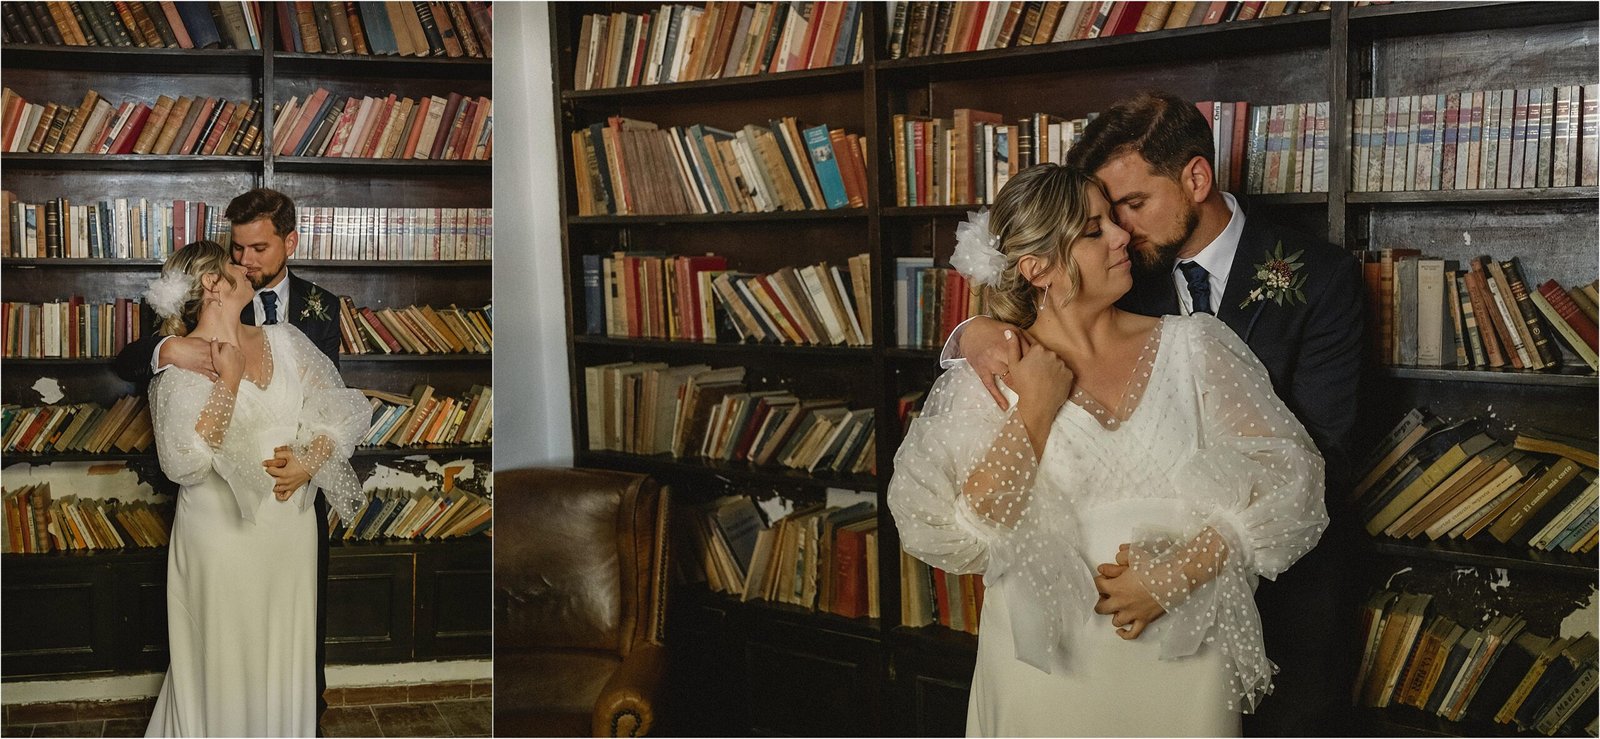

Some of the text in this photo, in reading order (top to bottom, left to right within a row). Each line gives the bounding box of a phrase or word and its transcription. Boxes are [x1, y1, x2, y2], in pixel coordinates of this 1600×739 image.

[1522, 503, 1532, 513] El
[1529, 486, 1548, 507] camino
[1546, 476, 1559, 490] más
[1557, 464, 1572, 480] corto
